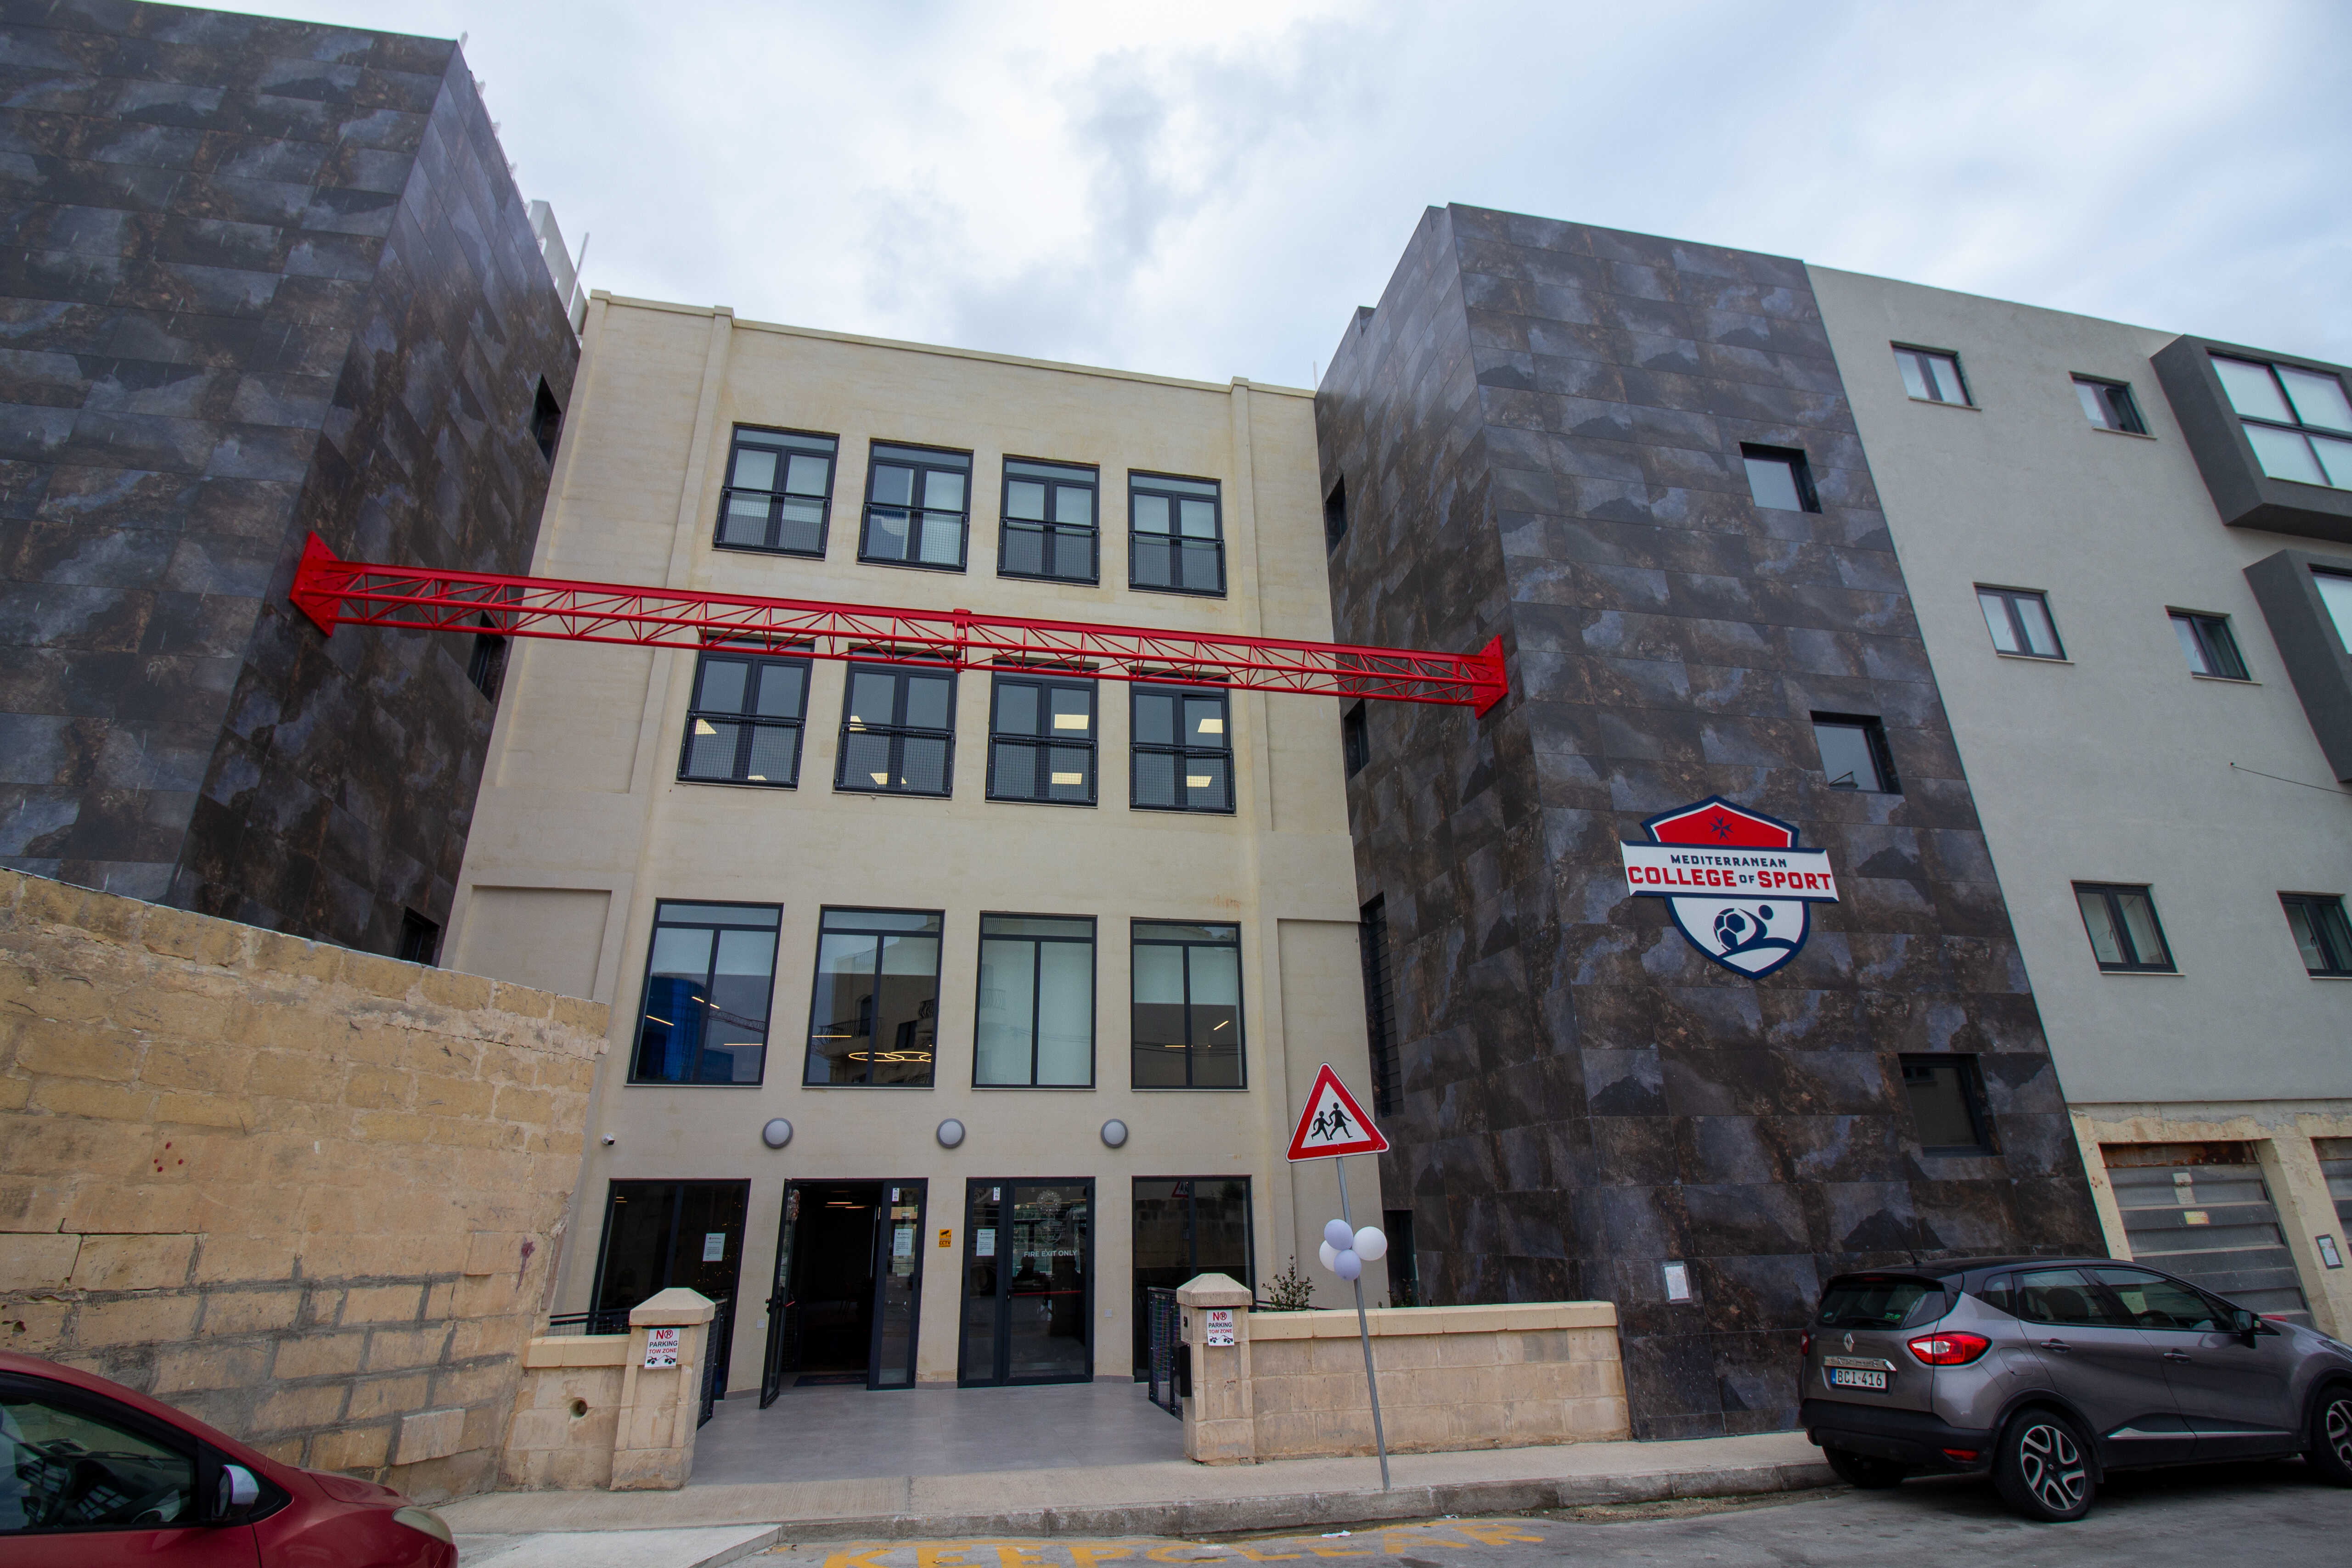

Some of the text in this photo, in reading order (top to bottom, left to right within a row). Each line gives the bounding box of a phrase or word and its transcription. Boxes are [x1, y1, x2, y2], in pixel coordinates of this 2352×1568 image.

[1671, 854, 1787, 868] MEDITERRANEAN
[1627, 866, 1831, 890] COLLEGE OF SPORT
[823, 1524, 1545, 1568] KEEP CLEAR
